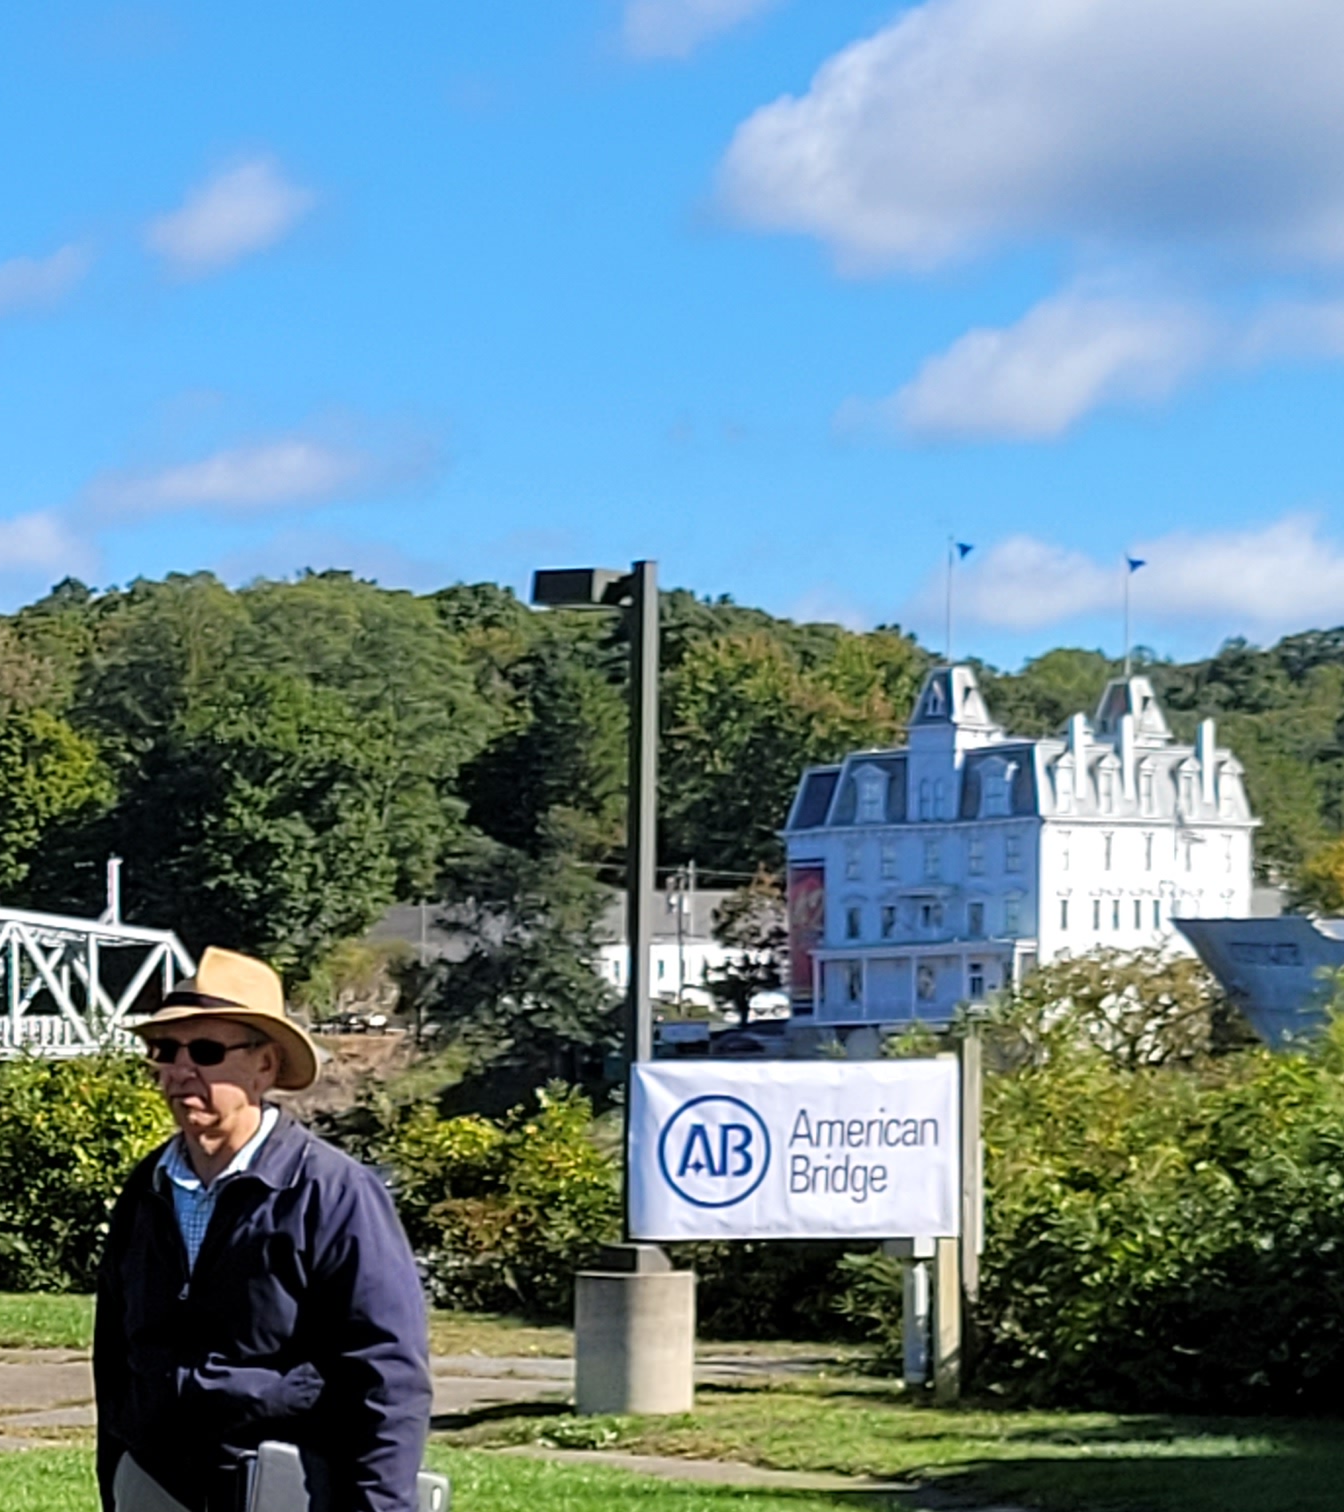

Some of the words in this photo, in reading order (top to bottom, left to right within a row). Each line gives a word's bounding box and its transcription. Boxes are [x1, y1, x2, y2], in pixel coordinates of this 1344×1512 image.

[676, 1123, 753, 1178] AB
[788, 1108, 939, 1149] American
[790, 1154, 888, 1203] Bridge
